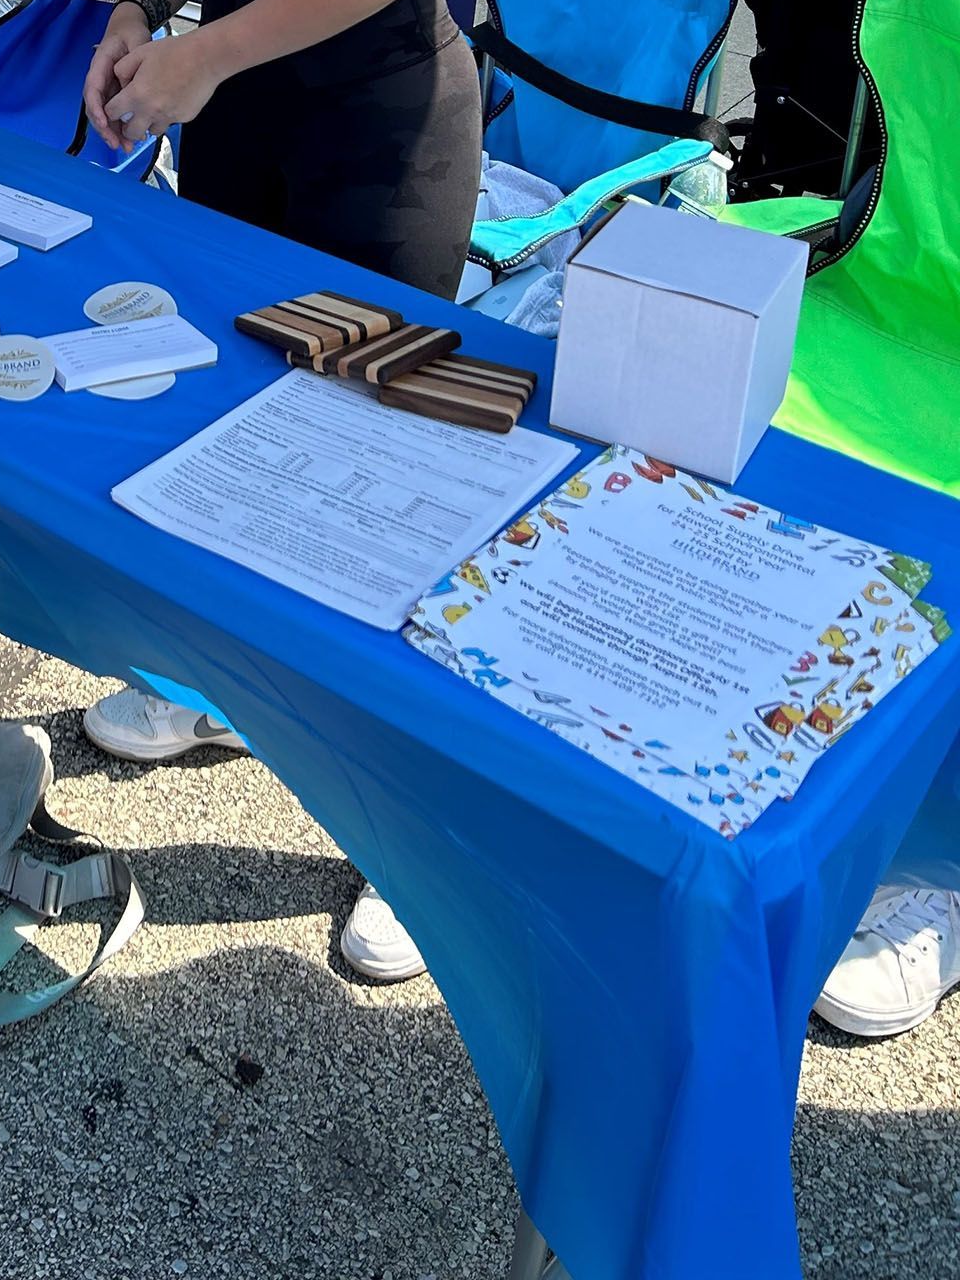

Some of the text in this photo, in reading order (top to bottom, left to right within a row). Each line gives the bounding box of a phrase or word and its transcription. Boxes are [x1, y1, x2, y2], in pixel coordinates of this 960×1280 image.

[657, 504, 675, 513] for
[676, 513, 722, 535] Hawley
[725, 534, 816, 575] Environmental
[683, 506, 804, 560] School Supply Drive
[712, 537, 753, 557] School
